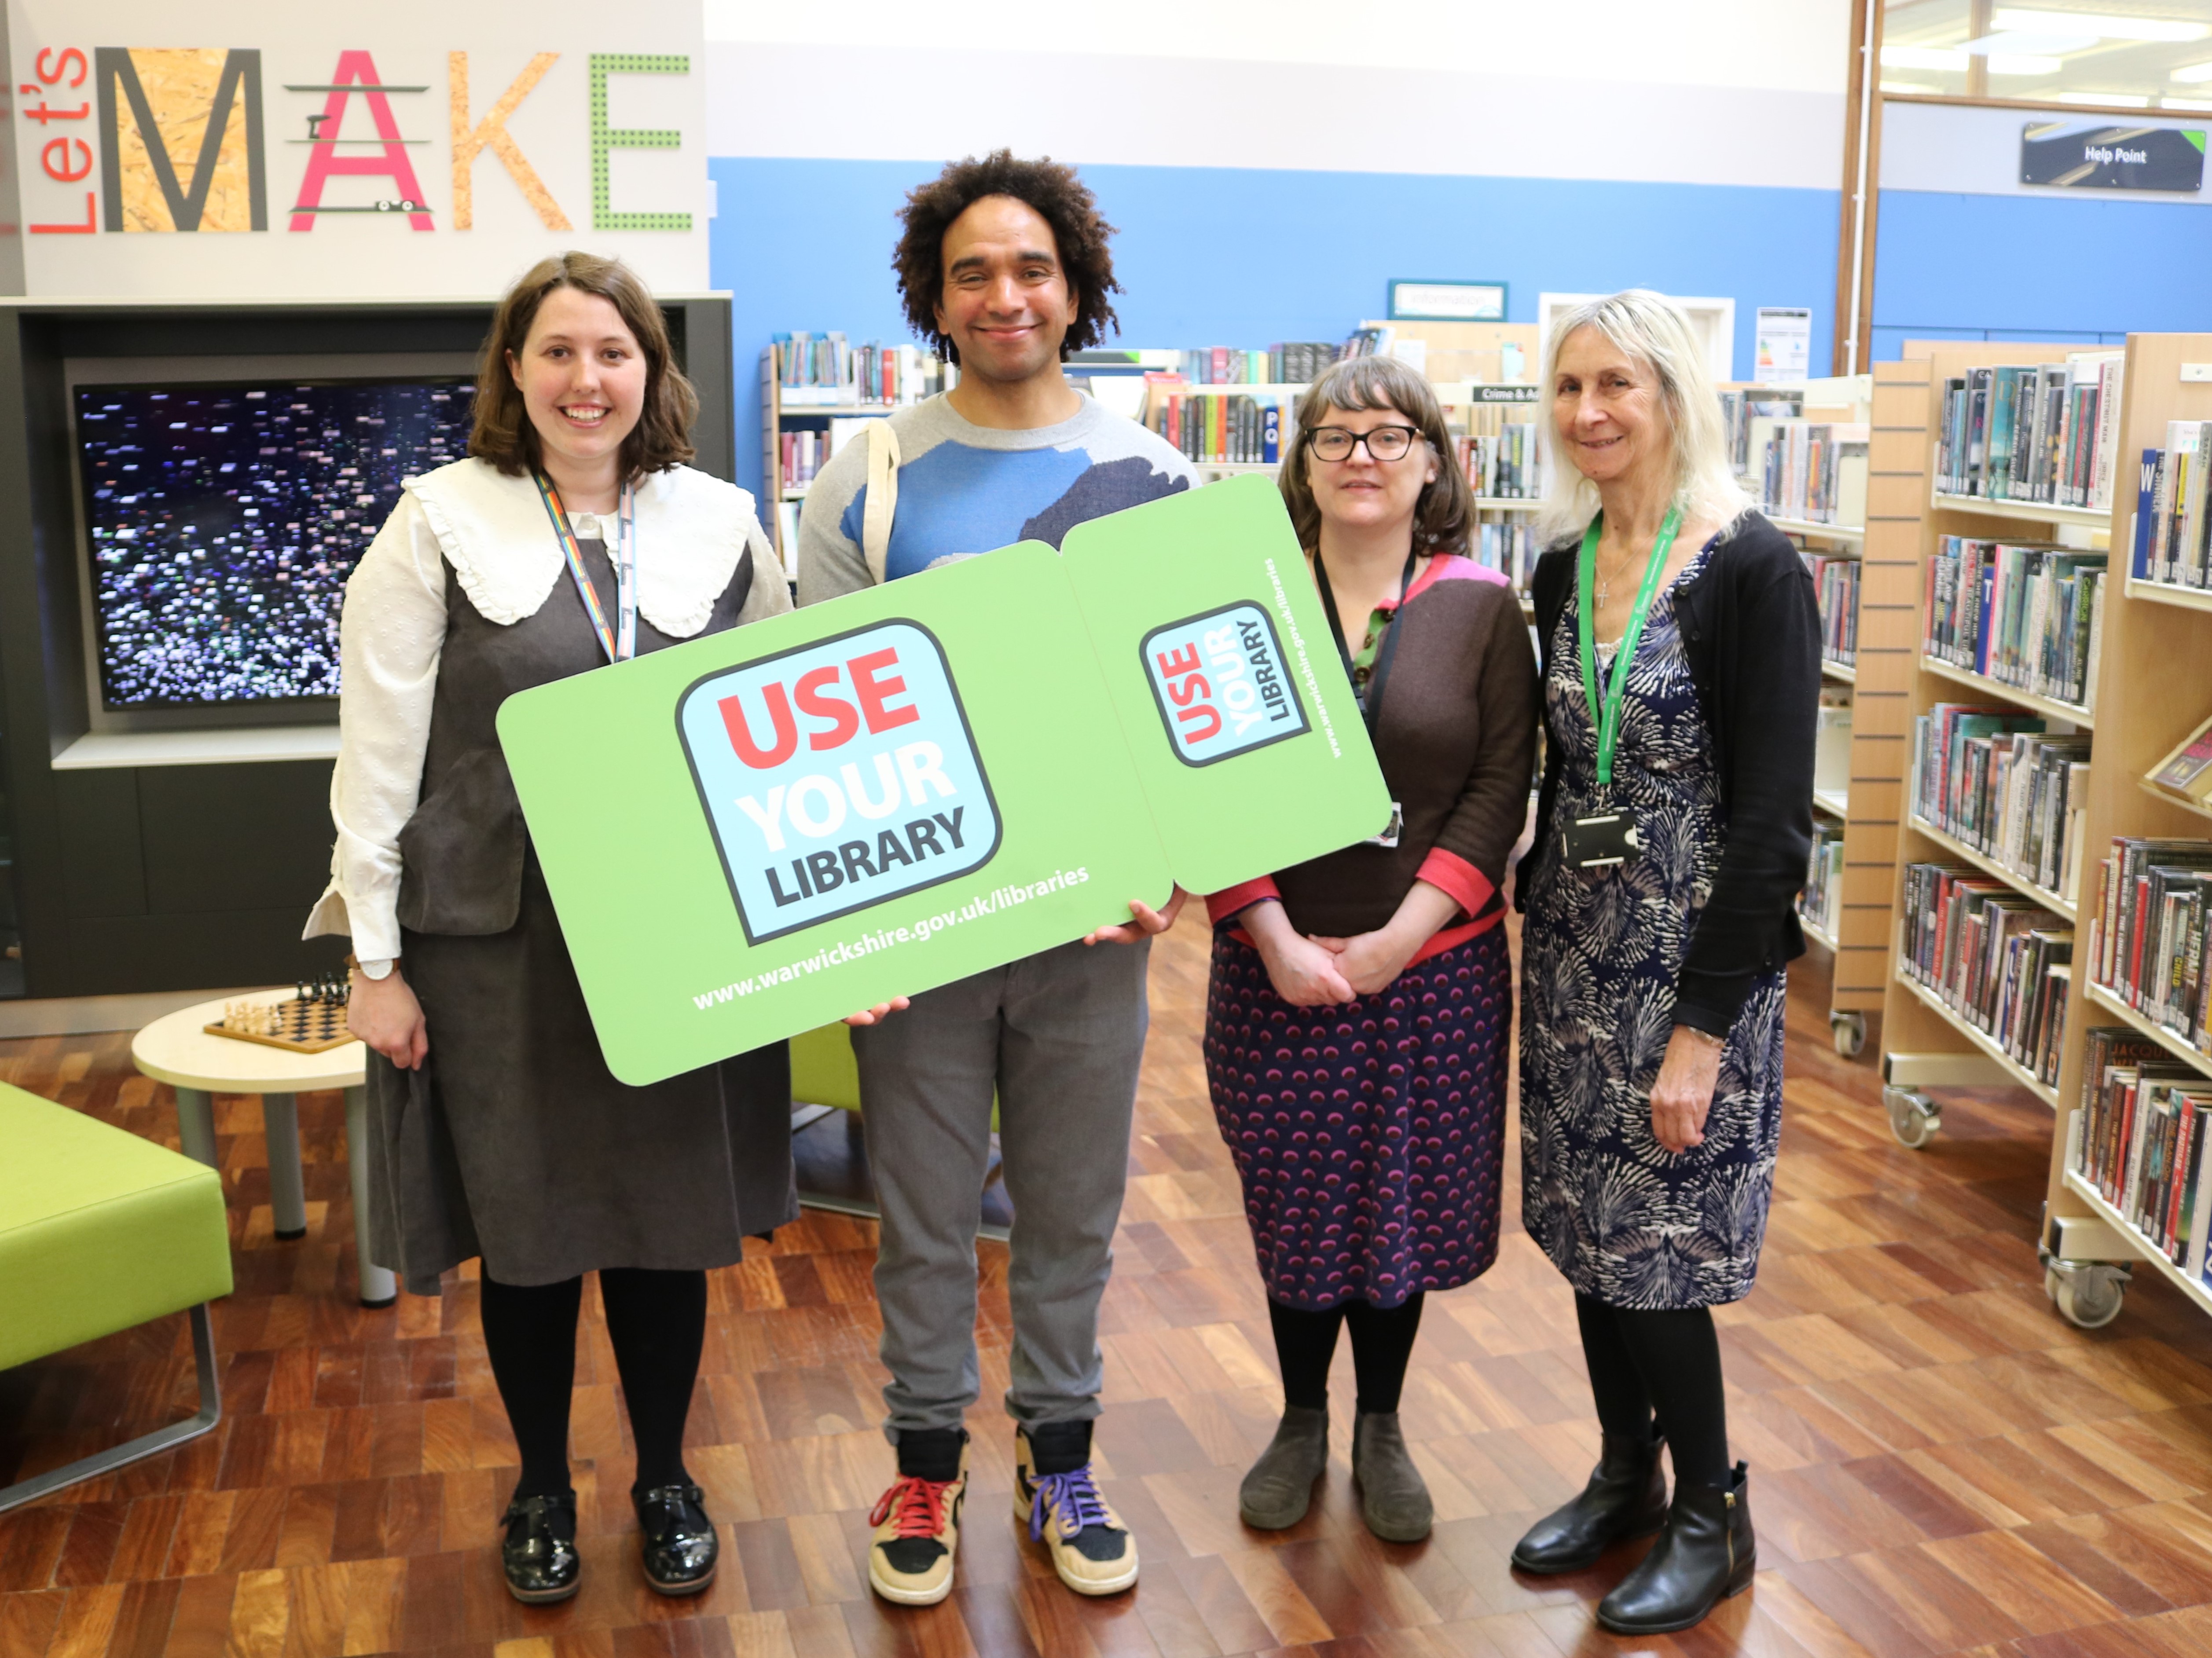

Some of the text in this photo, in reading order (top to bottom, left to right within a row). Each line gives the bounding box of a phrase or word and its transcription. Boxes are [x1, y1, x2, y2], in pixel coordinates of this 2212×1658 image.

[20, 47, 96, 235] Let's
[95, 46, 693, 232] MAKE
[2084, 146, 2147, 165] Help Point
[1265, 428, 1278, 445] Q
[1266, 411, 1278, 427] P
[1482, 388, 1514, 401] Crime
[1515, 388, 1526, 401] &
[717, 647, 920, 769] USE
[1156, 641, 1222, 745] USE
[1203, 623, 1264, 737] YOUR
[1236, 620, 1290, 721] LIBRARY
[1264, 557, 1342, 759] www.warwickshire.gov.uk/libraries
[734, 739, 957, 854] YOUR
[764, 805, 965, 908] LIBRARY
[692, 865, 1090, 1011] www.warwickshire.gov.uk/libraries
[2172, 957, 2183, 987] CHILD
[2186, 930, 2202, 989] HERMIT
